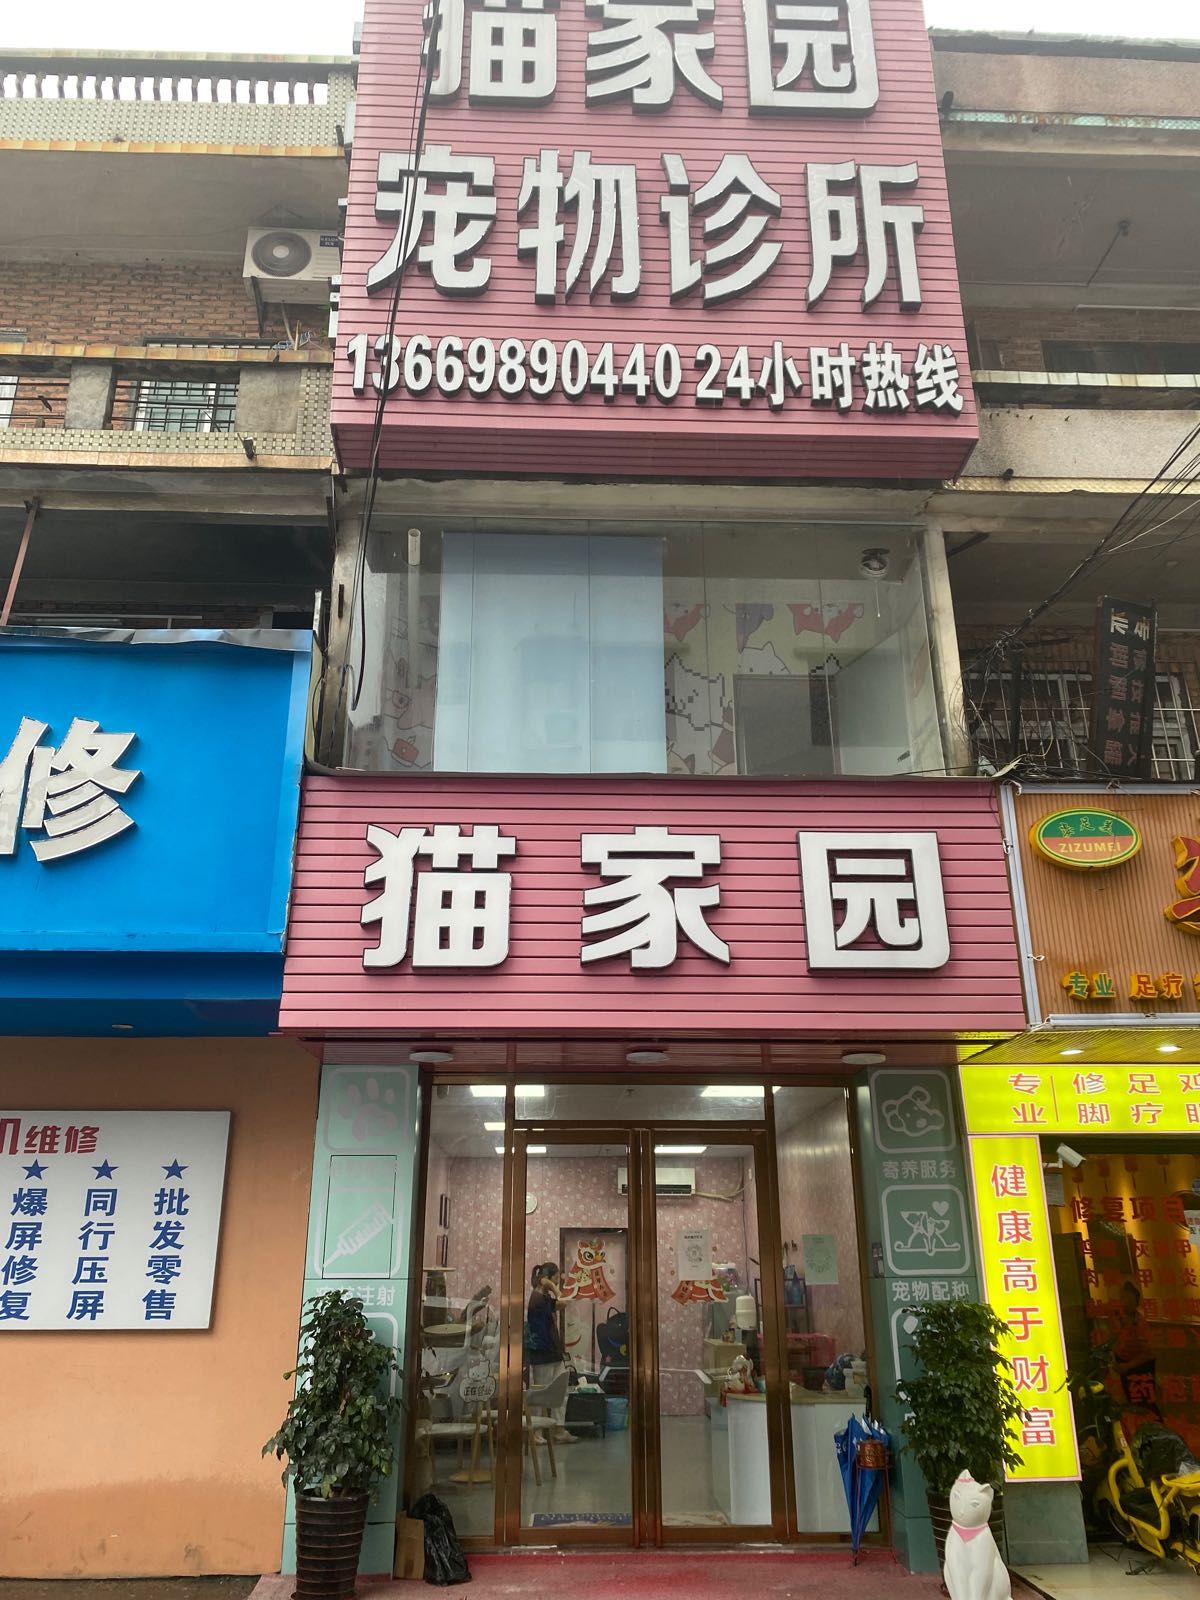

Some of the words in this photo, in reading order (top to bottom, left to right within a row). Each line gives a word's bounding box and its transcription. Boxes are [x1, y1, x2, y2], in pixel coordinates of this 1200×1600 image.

[367, 145, 924, 310] 宠物诊所
[347, 333, 682, 402] 13669890440
[694, 341, 964, 414] 24小时热线
[0, 716, 143, 864] 修
[1058, 841, 1122, 854] ZIZUMEI
[360, 823, 951, 972] 猫家园
[1064, 971, 1117, 1000] 专业
[1130, 972, 1185, 1001] 足疗
[1008, 1073, 1048, 1124] 专业
[1072, 1073, 1111, 1125] 修脚
[1128, 1073, 1164, 1124] 足疗
[882, 1160, 957, 1180] 寄养服务
[0, 1187, 49, 1321] 爆屏修复
[66, 1187, 118, 1321] 同行压屏
[141, 1187, 190, 1321] 批发零售
[892, 1281, 970, 1302] 宠物配种
[990, 1164, 1056, 1447] 健康高于财富
